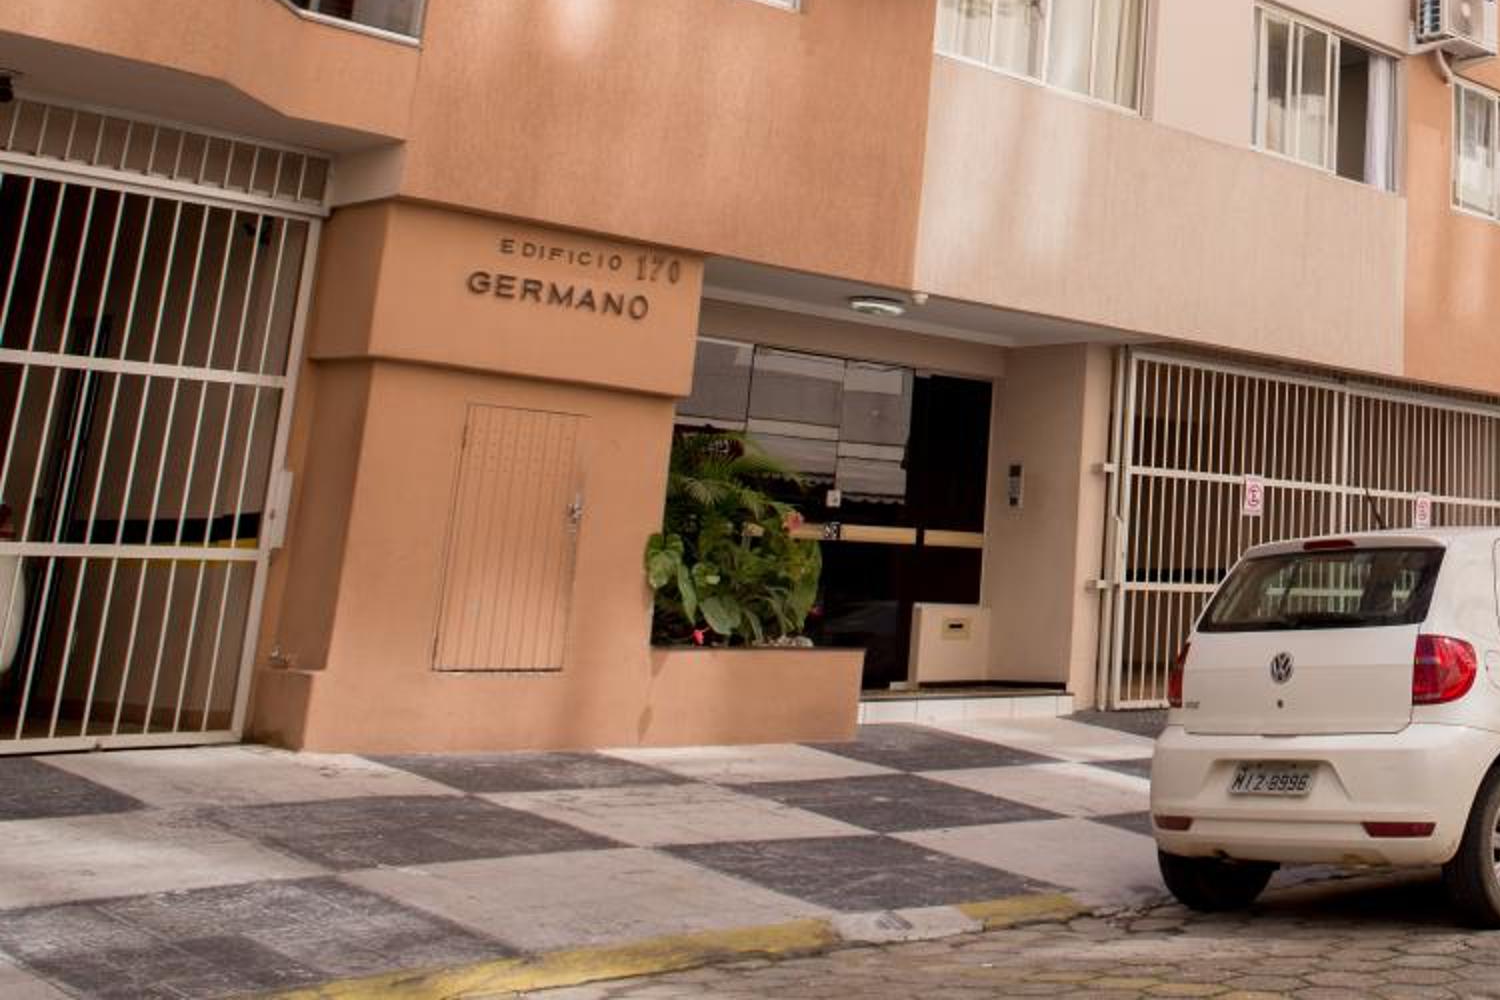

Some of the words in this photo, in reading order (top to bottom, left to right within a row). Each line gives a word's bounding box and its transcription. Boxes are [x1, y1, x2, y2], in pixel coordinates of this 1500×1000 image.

[500, 239, 622, 272] EDIFICIO
[636, 252, 681, 285] 170
[466, 271, 649, 320] GERMANO
